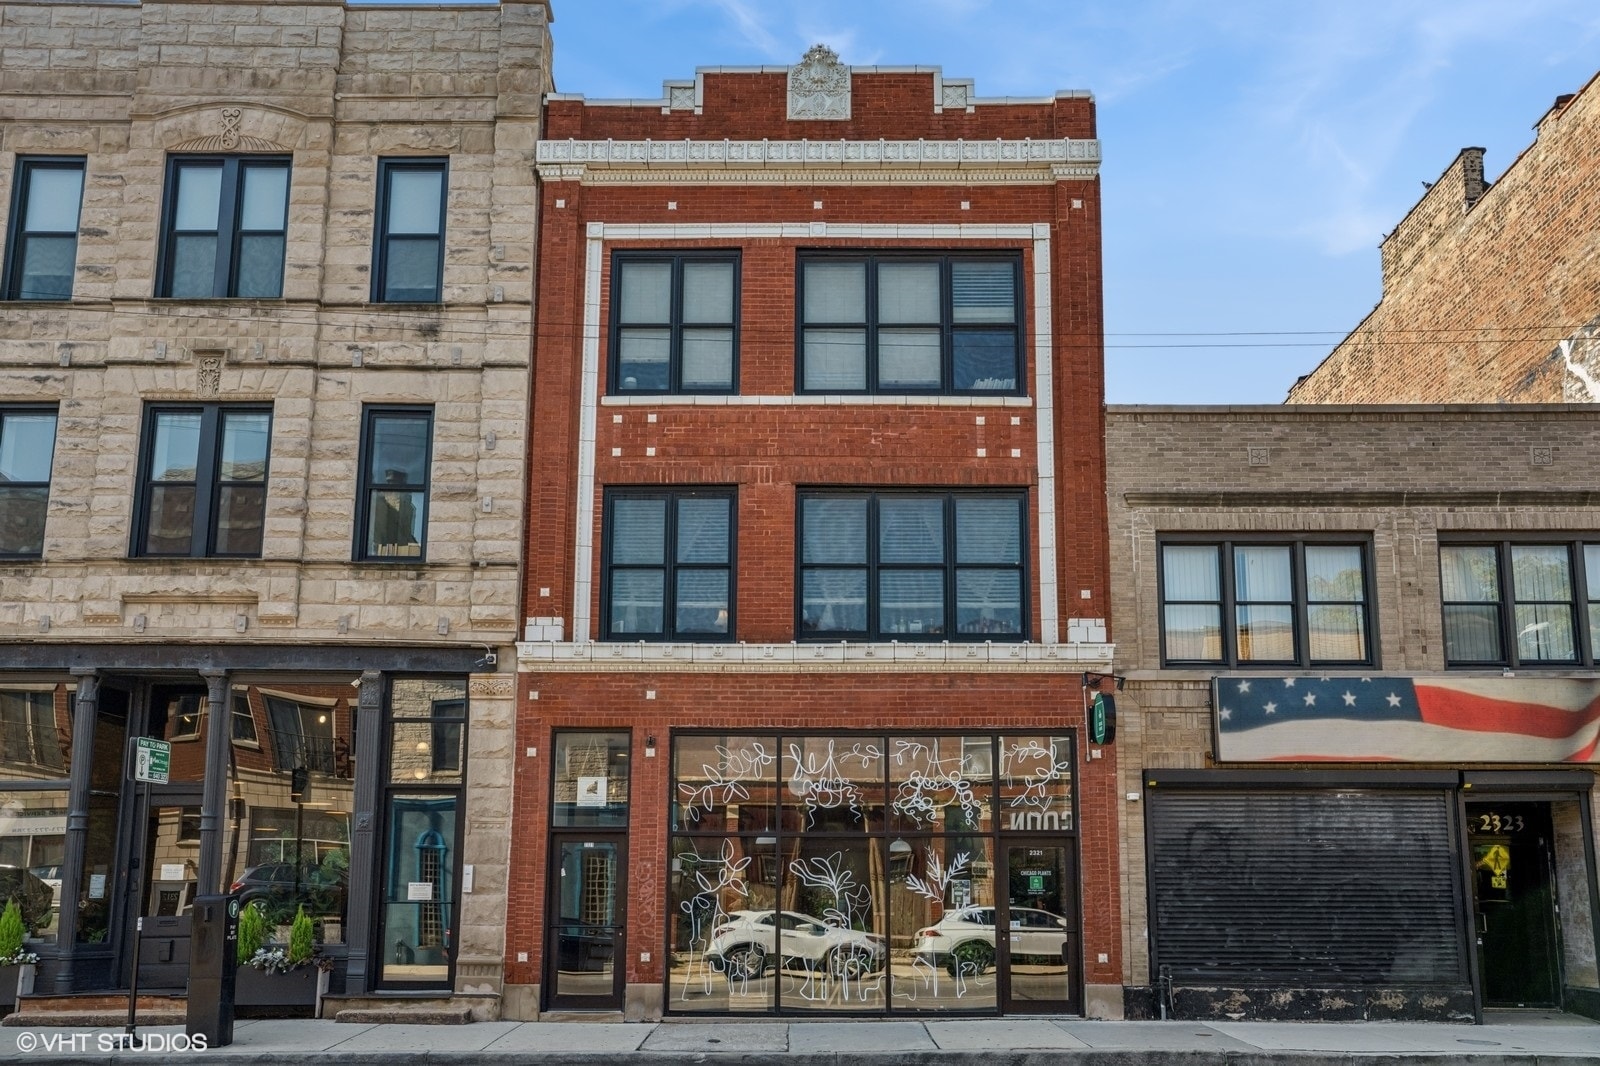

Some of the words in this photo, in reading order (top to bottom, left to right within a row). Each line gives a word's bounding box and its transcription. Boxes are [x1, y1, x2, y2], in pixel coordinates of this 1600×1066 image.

[140, 739, 149, 747] PAY
[156, 742, 168, 750] PARK
[1480, 814, 1524, 832] 2323
